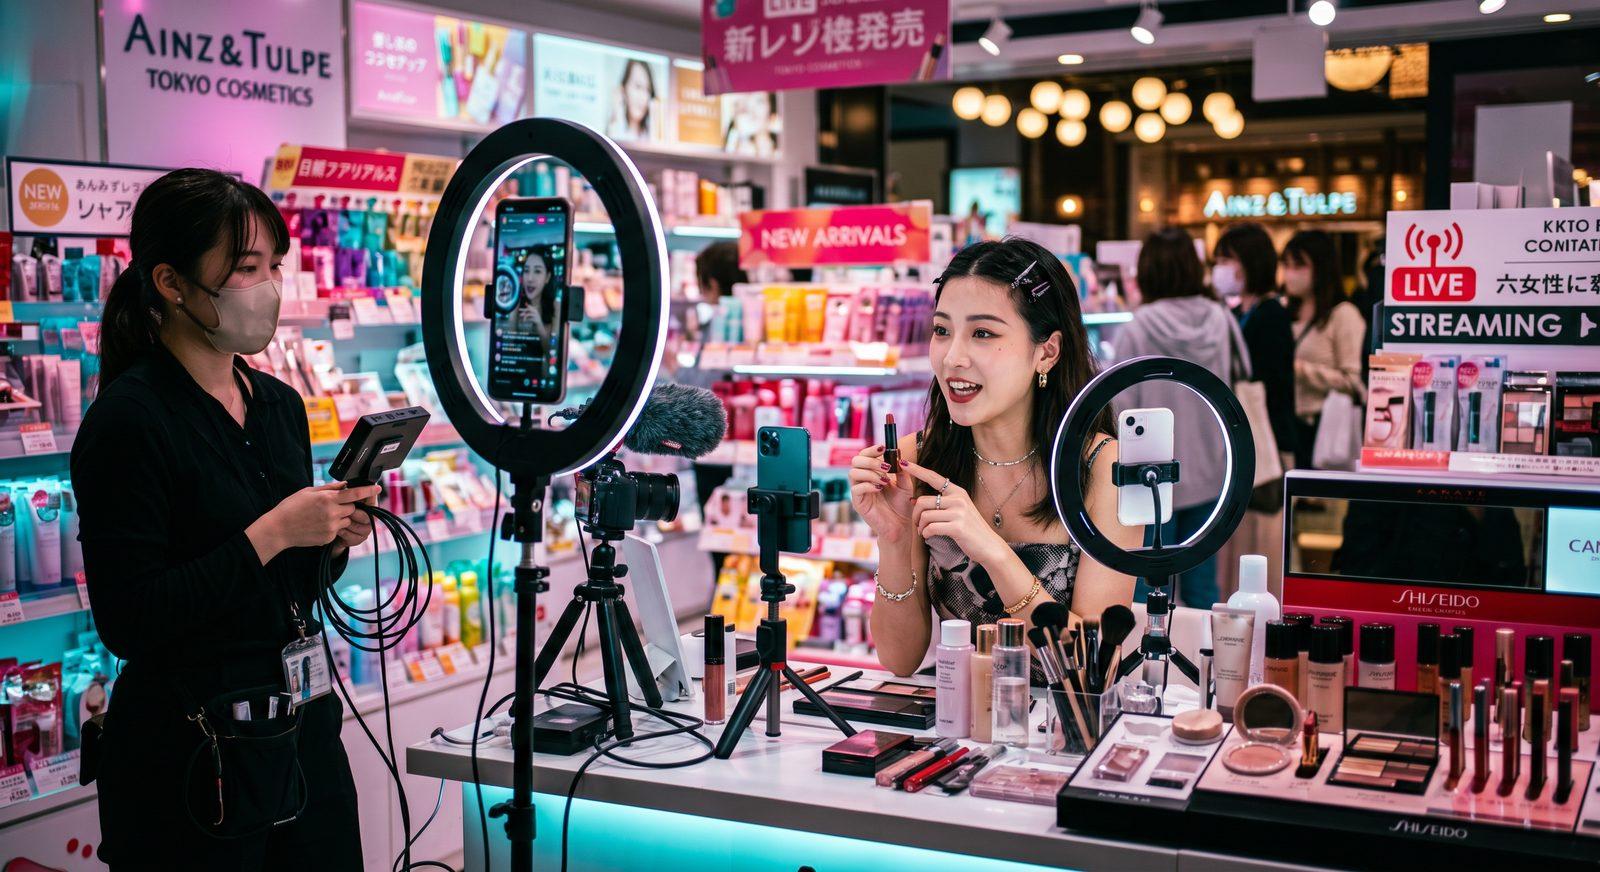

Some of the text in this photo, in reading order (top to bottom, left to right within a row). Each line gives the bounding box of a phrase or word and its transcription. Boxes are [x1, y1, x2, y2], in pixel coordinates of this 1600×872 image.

[146, 68, 313, 107] TOKYO COSMETICS
[25, 183, 62, 200] NEW
[1543, 219, 1589, 233] KKTO
[760, 223, 907, 250] NEW ARRIVALS
[1524, 239, 1600, 252] CONITAT
[1404, 273, 1464, 297] LIVE
[1390, 312, 1562, 338] STREAMING
[1392, 589, 1479, 608] SHISEIDO
[1389, 819, 1468, 839] SHISEIDO
